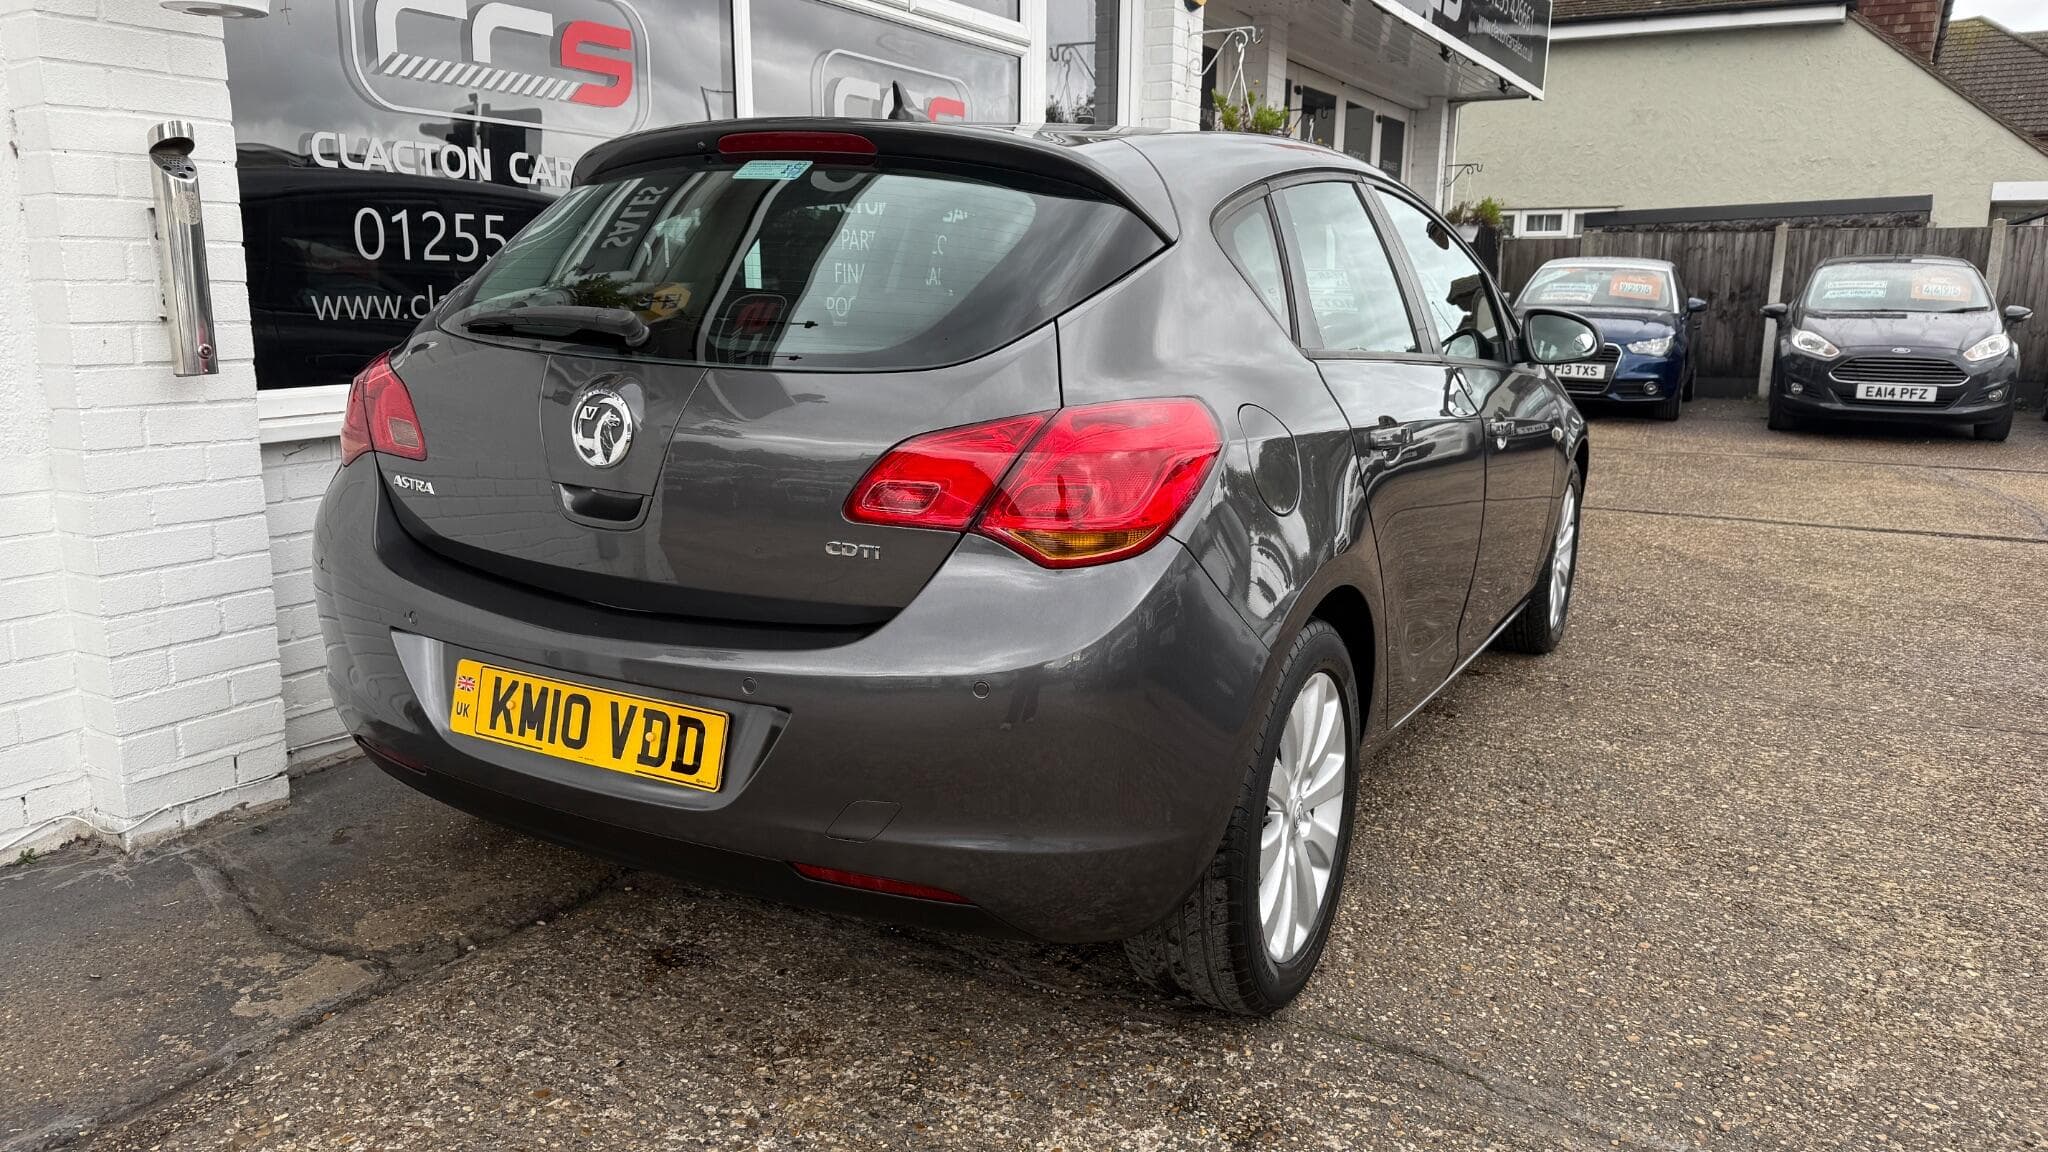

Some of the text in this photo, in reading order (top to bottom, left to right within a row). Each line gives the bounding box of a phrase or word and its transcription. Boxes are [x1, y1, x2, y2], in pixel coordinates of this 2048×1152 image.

[310, 131, 492, 181] CLACTON
[1575, 365, 1598, 377] TXS
[1865, 386, 1929, 400] EA14 PFZ
[393, 474, 435, 495] ASTRA
[455, 701, 471, 718] UK
[489, 676, 706, 776] KM10 VDD
